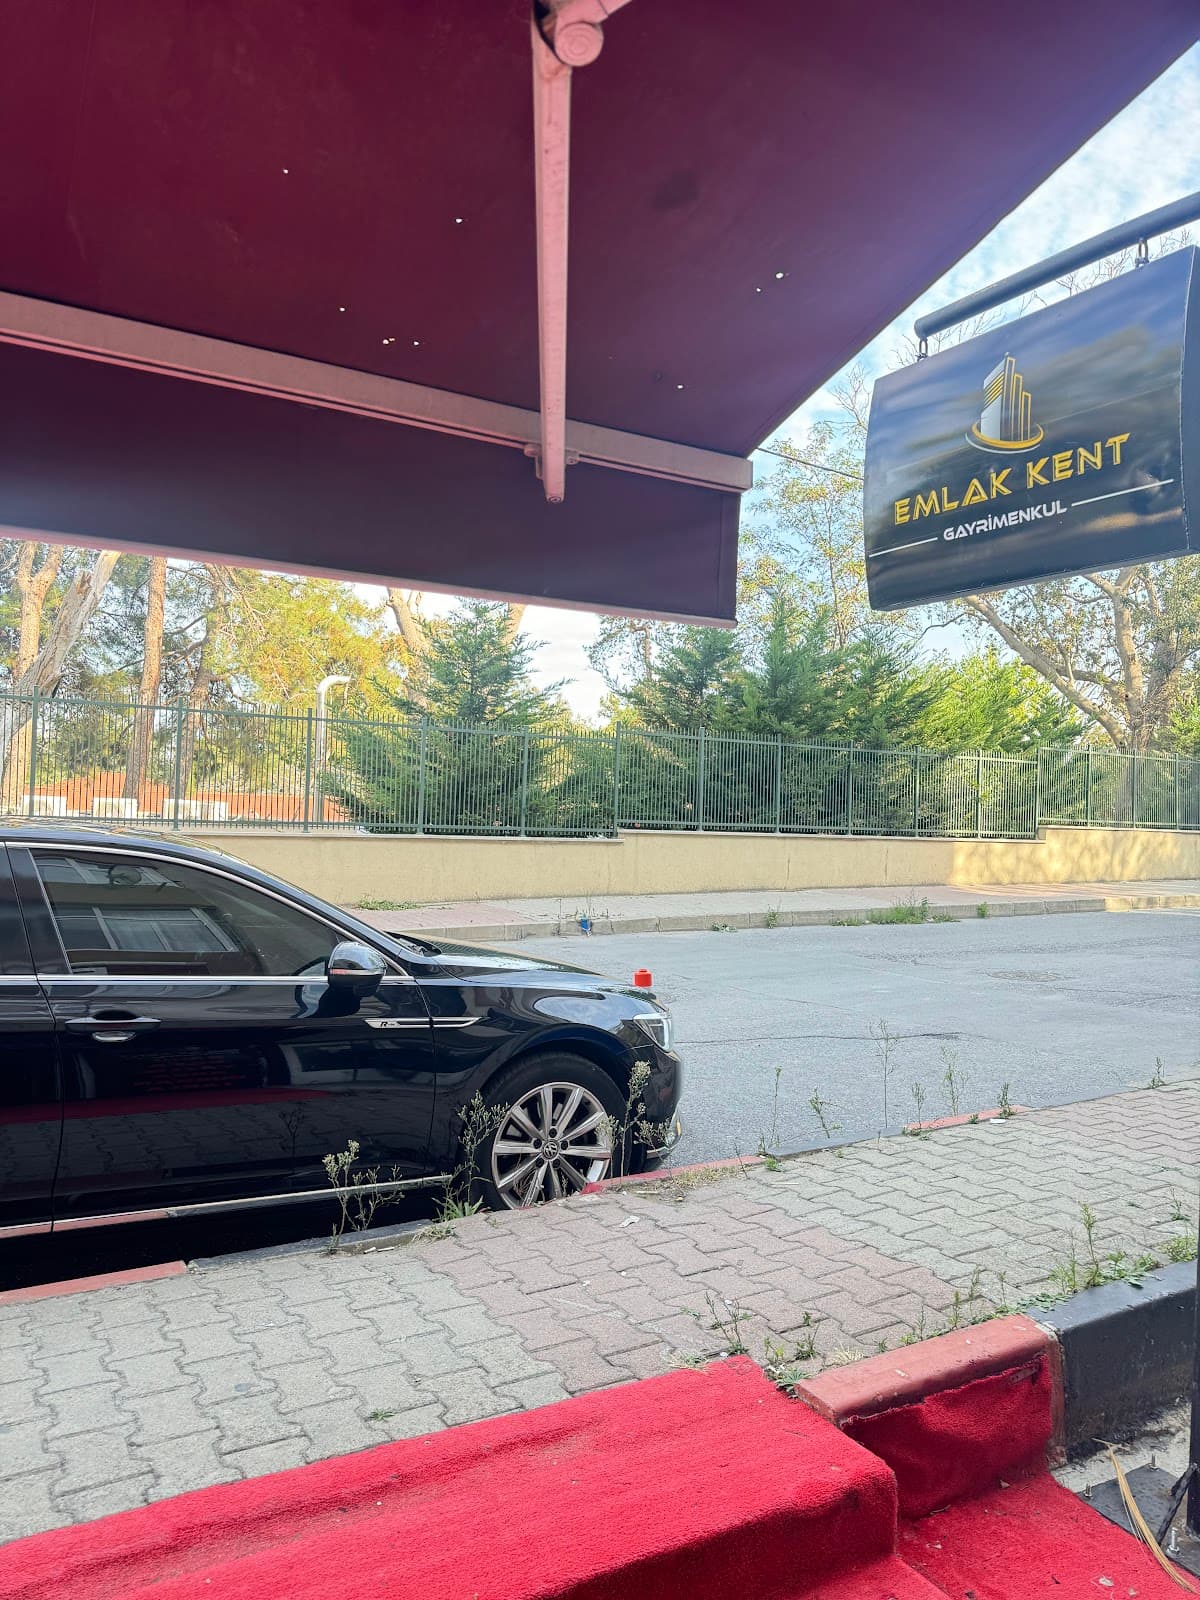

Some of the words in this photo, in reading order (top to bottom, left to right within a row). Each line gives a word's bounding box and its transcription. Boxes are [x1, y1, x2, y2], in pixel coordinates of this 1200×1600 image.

[895, 468, 1012, 525] EMLAK
[1026, 433, 1130, 488] KENT
[943, 500, 1067, 541] GAYRİMENKUL
